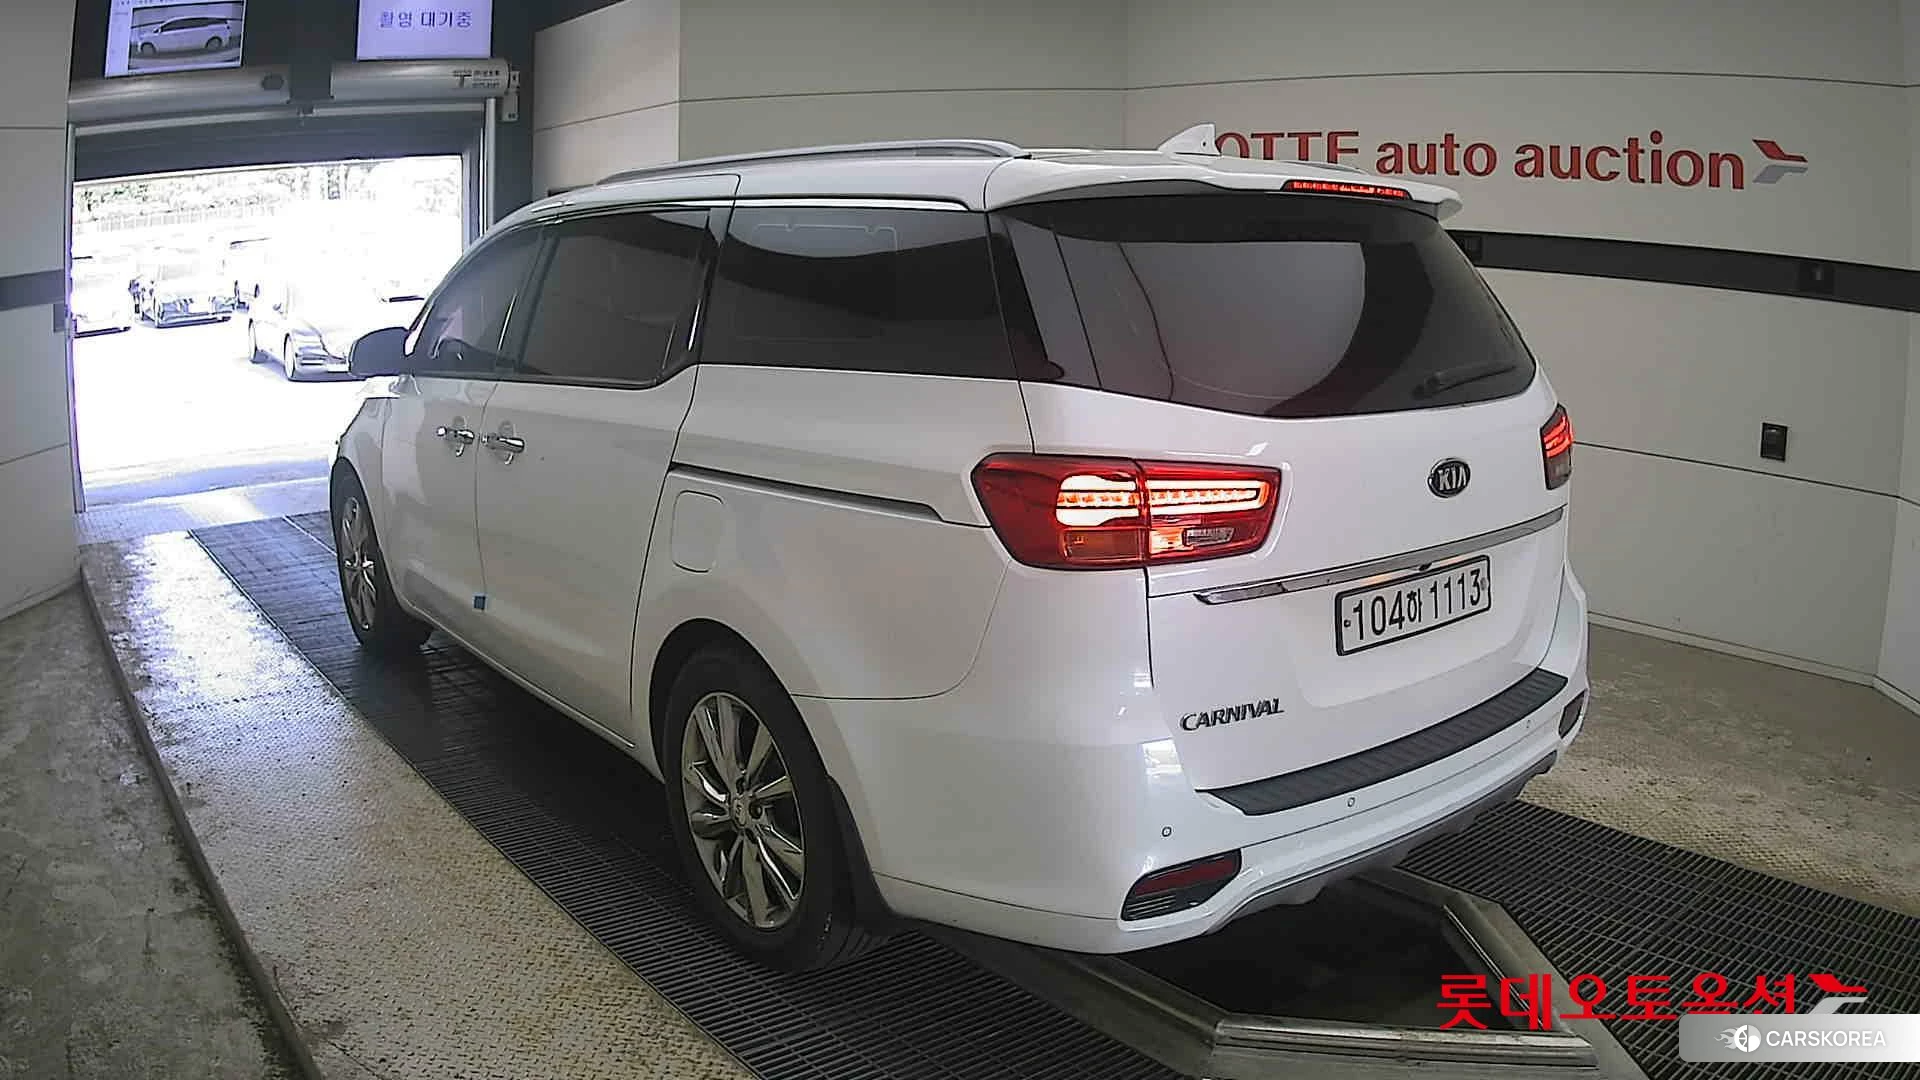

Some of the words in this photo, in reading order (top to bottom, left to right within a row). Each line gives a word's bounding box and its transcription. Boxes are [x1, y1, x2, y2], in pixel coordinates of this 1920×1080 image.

[421, 11, 472, 28] 대기중
[1214, 131, 1360, 165] OTTE
[1375, 133, 1497, 177] auto
[1513, 130, 1745, 190] auction
[1437, 466, 1467, 491] KIA
[1353, 588, 1423, 641] 104하
[1430, 568, 1482, 620] 1113
[1180, 698, 1285, 732] CARNIVAL
